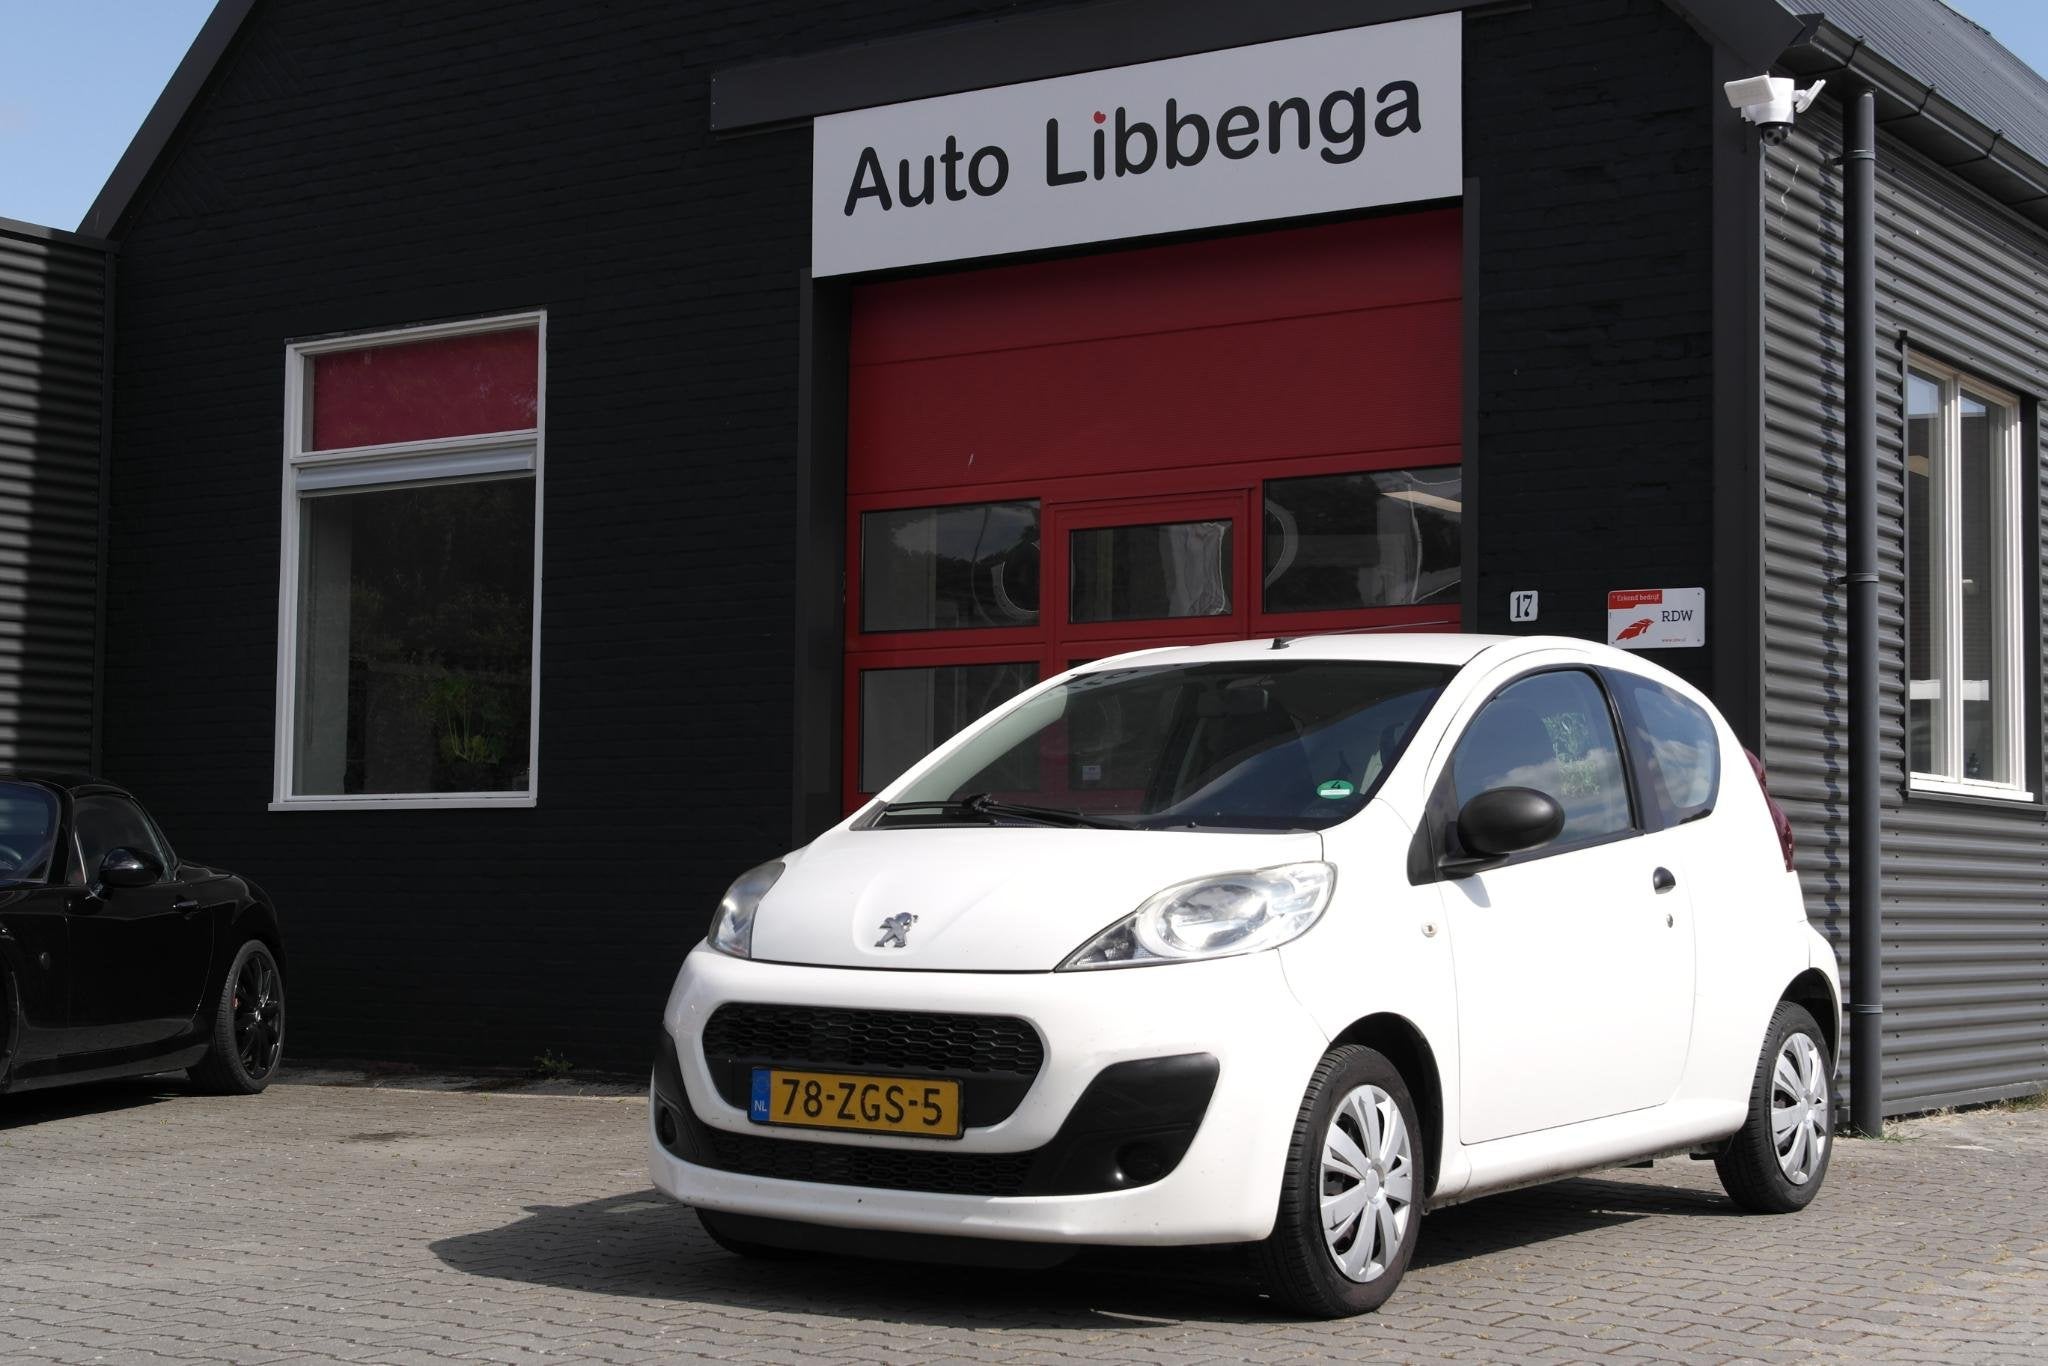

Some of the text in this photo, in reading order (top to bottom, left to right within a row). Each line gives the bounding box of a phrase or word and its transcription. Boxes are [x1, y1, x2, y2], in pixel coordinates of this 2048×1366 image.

[843, 80, 1422, 217] Auto Libbenga
[1514, 594, 1533, 618] 17
[1661, 610, 1693, 622] RDW
[1331, 781, 1341, 789] 4
[754, 1100, 767, 1112] NL
[782, 1078, 943, 1126] 78-ZGS-5
